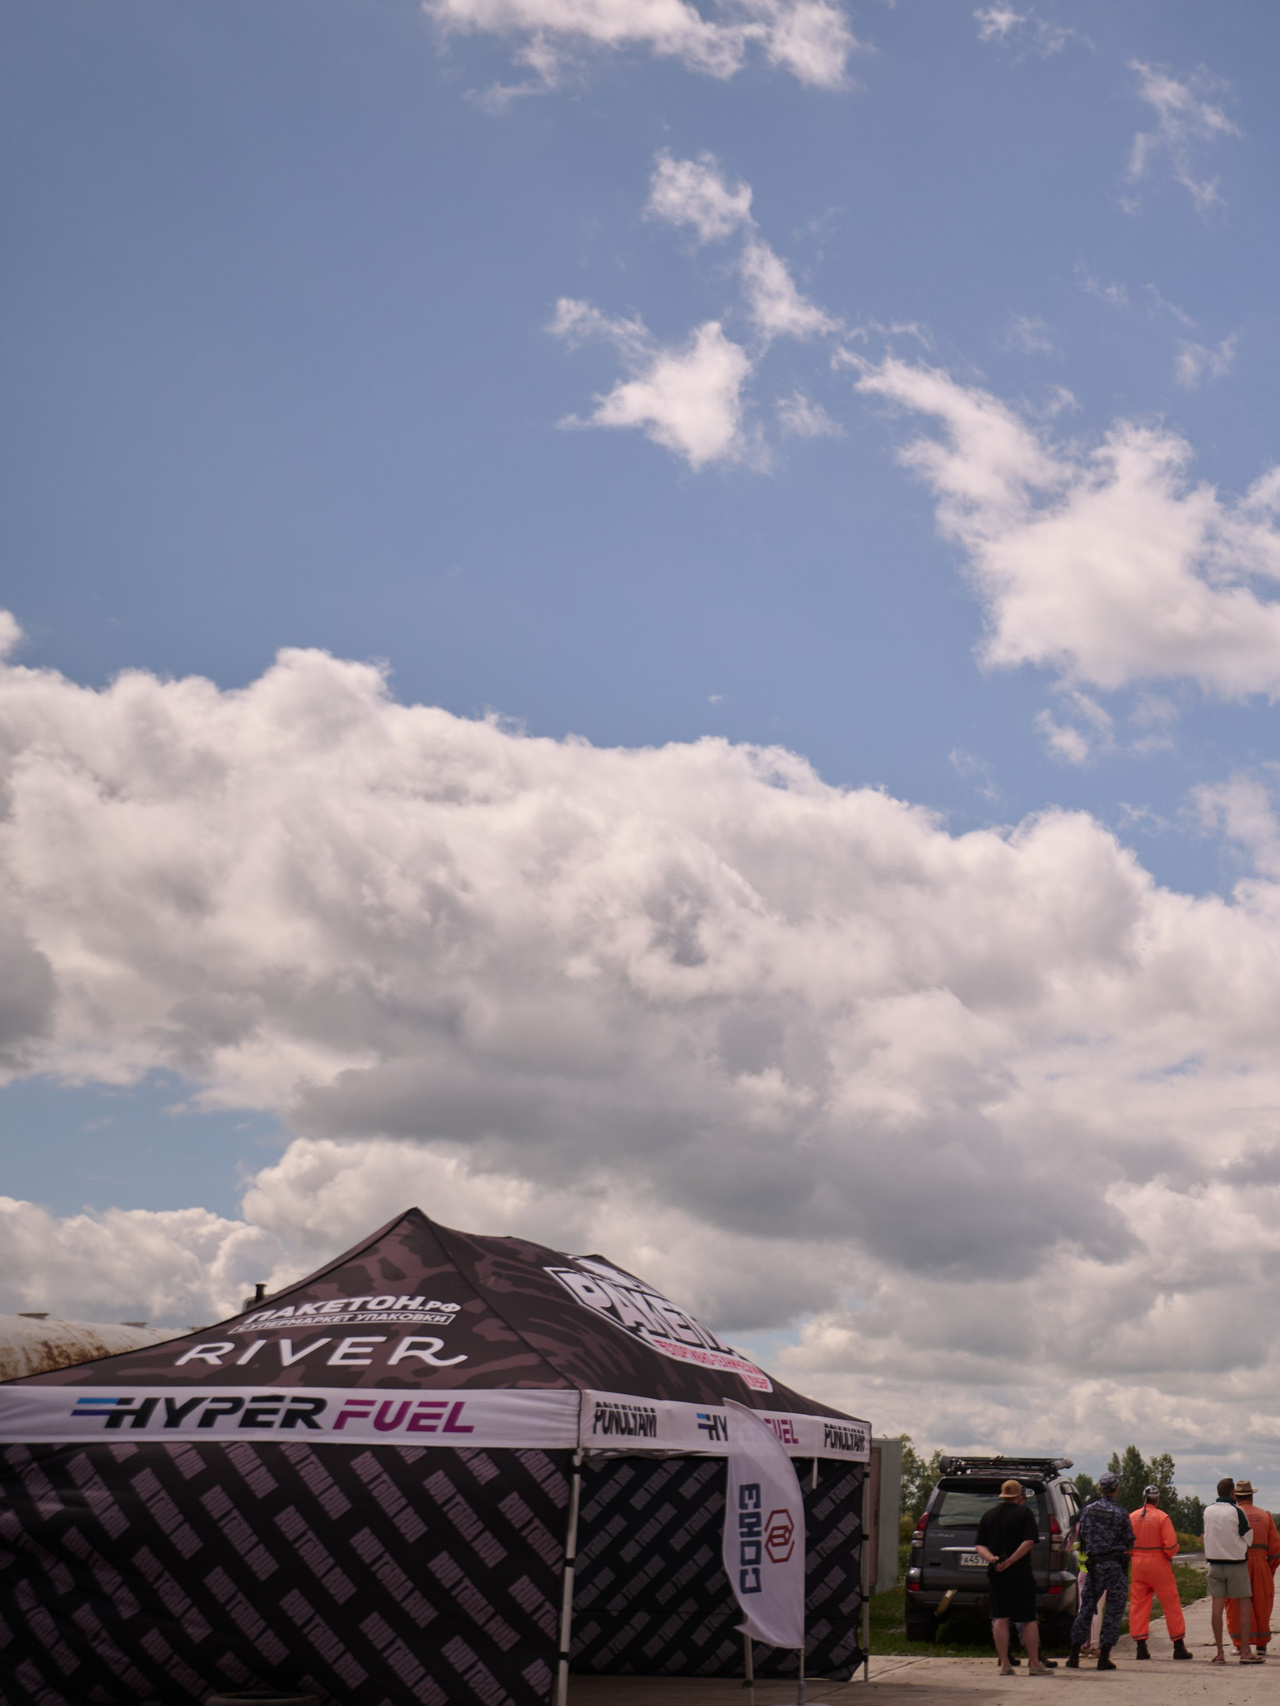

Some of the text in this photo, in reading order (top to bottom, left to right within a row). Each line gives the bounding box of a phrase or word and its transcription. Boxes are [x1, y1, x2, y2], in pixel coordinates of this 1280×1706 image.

[243, 1295, 462, 1324] ПАКЕТОН.РФ
[354, 1313, 447, 1323] УПАКОВКИ
[175, 1336, 469, 1366] RIVER
[102, 1395, 475, 1433] HYPER FUEL
[763, 1418, 799, 1444] UEL
[739, 1483, 762, 1594] СОЮЗ
